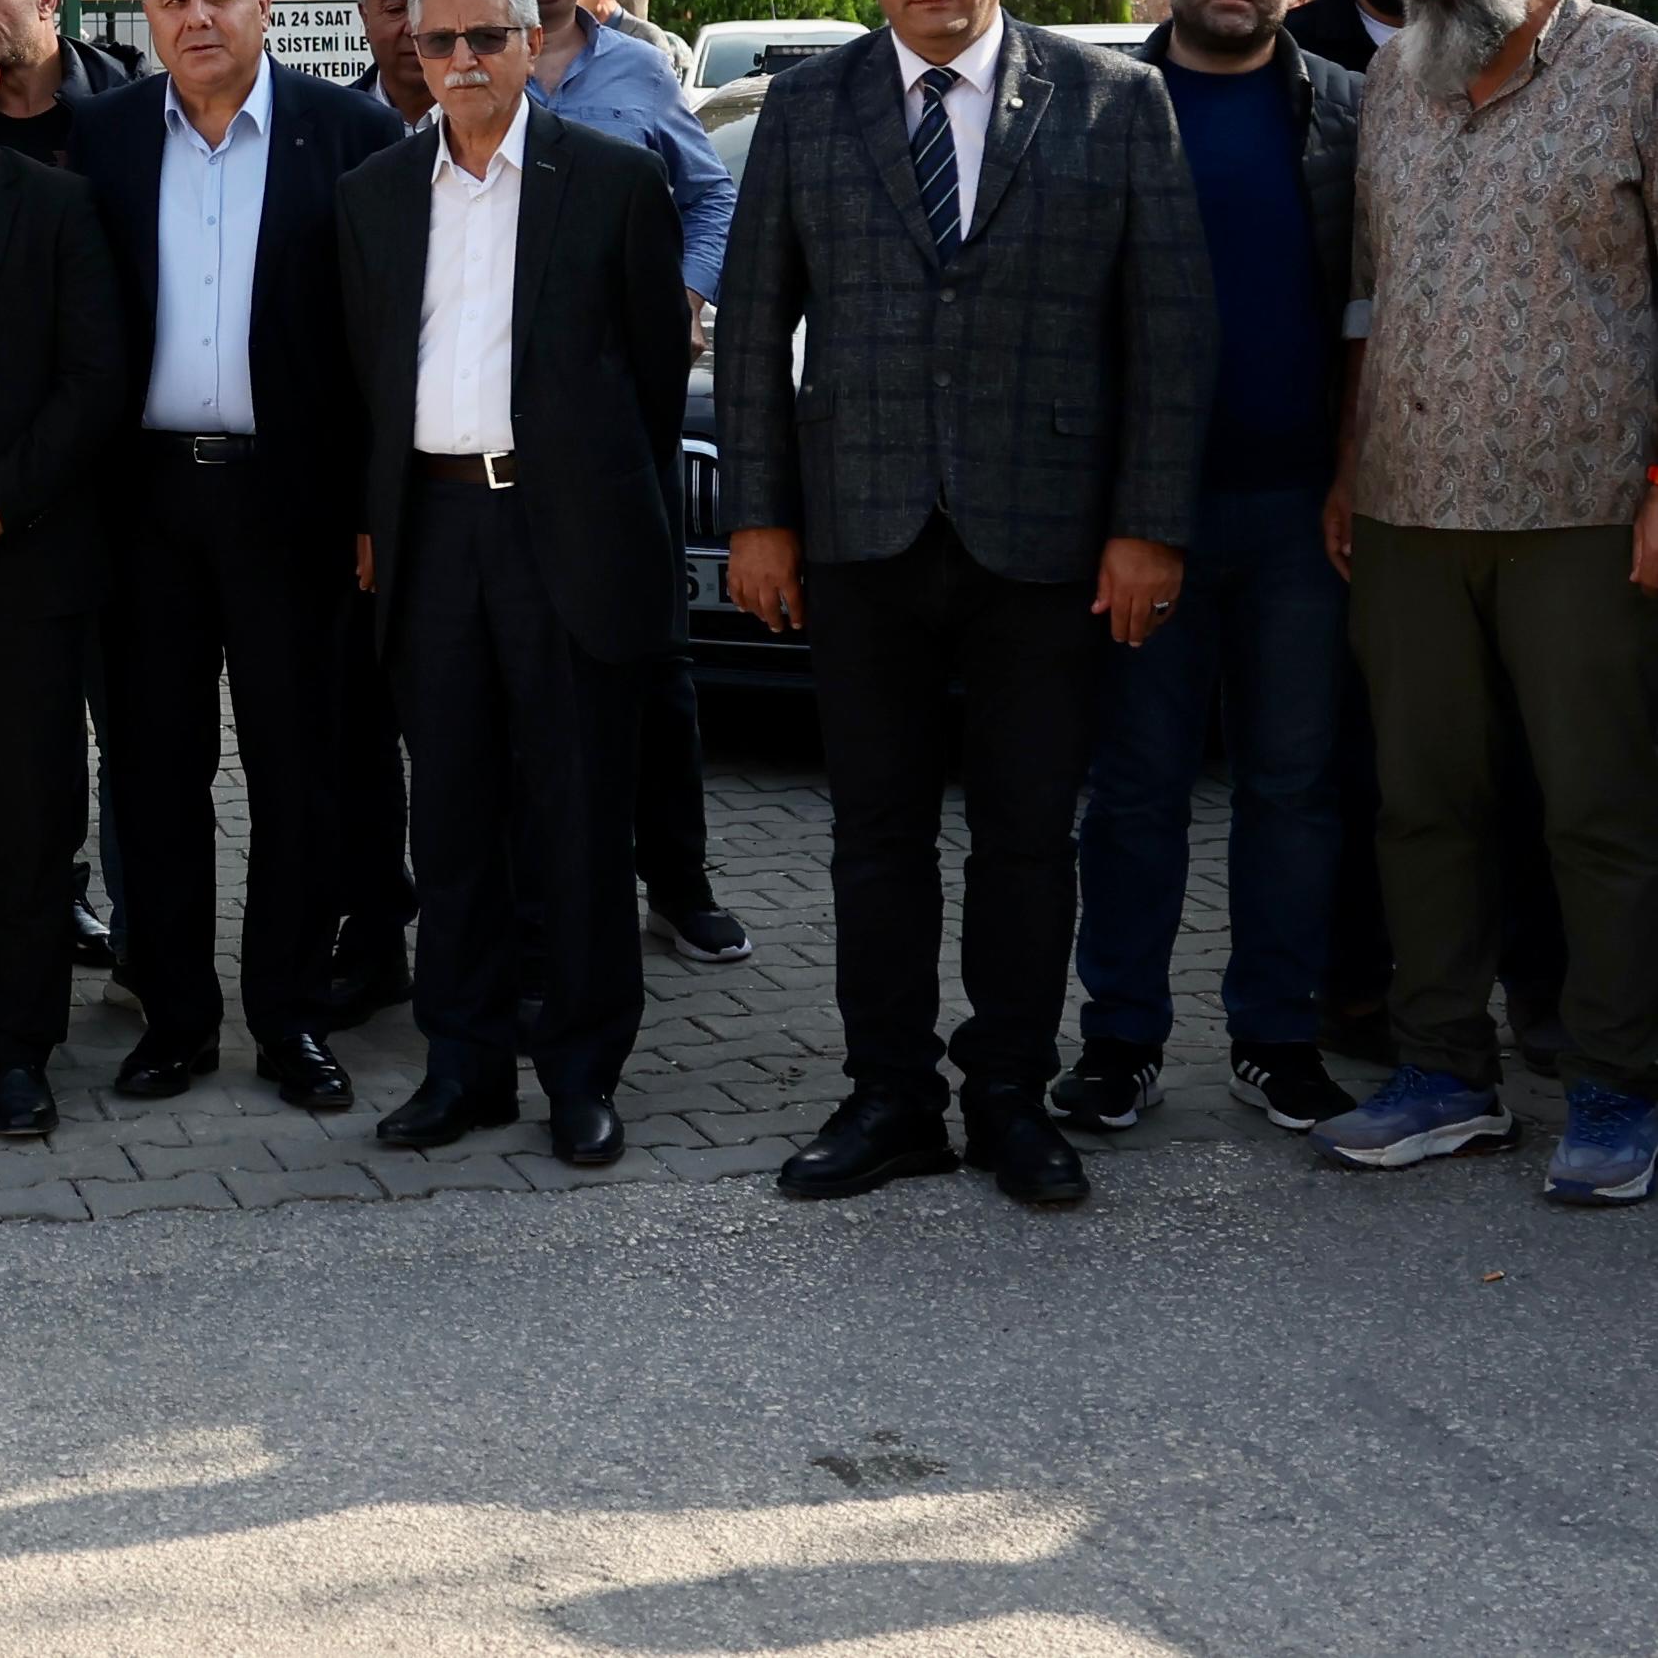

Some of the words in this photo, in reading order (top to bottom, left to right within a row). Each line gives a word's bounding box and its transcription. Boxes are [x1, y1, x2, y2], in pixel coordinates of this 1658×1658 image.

[291, 11, 309, 27] 24
[315, 10, 352, 26] SAAT
[277, 32, 339, 53] SİSTEMİ
[345, 32, 368, 52] İLE
[286, 57, 366, 78] MEKTEDİR
